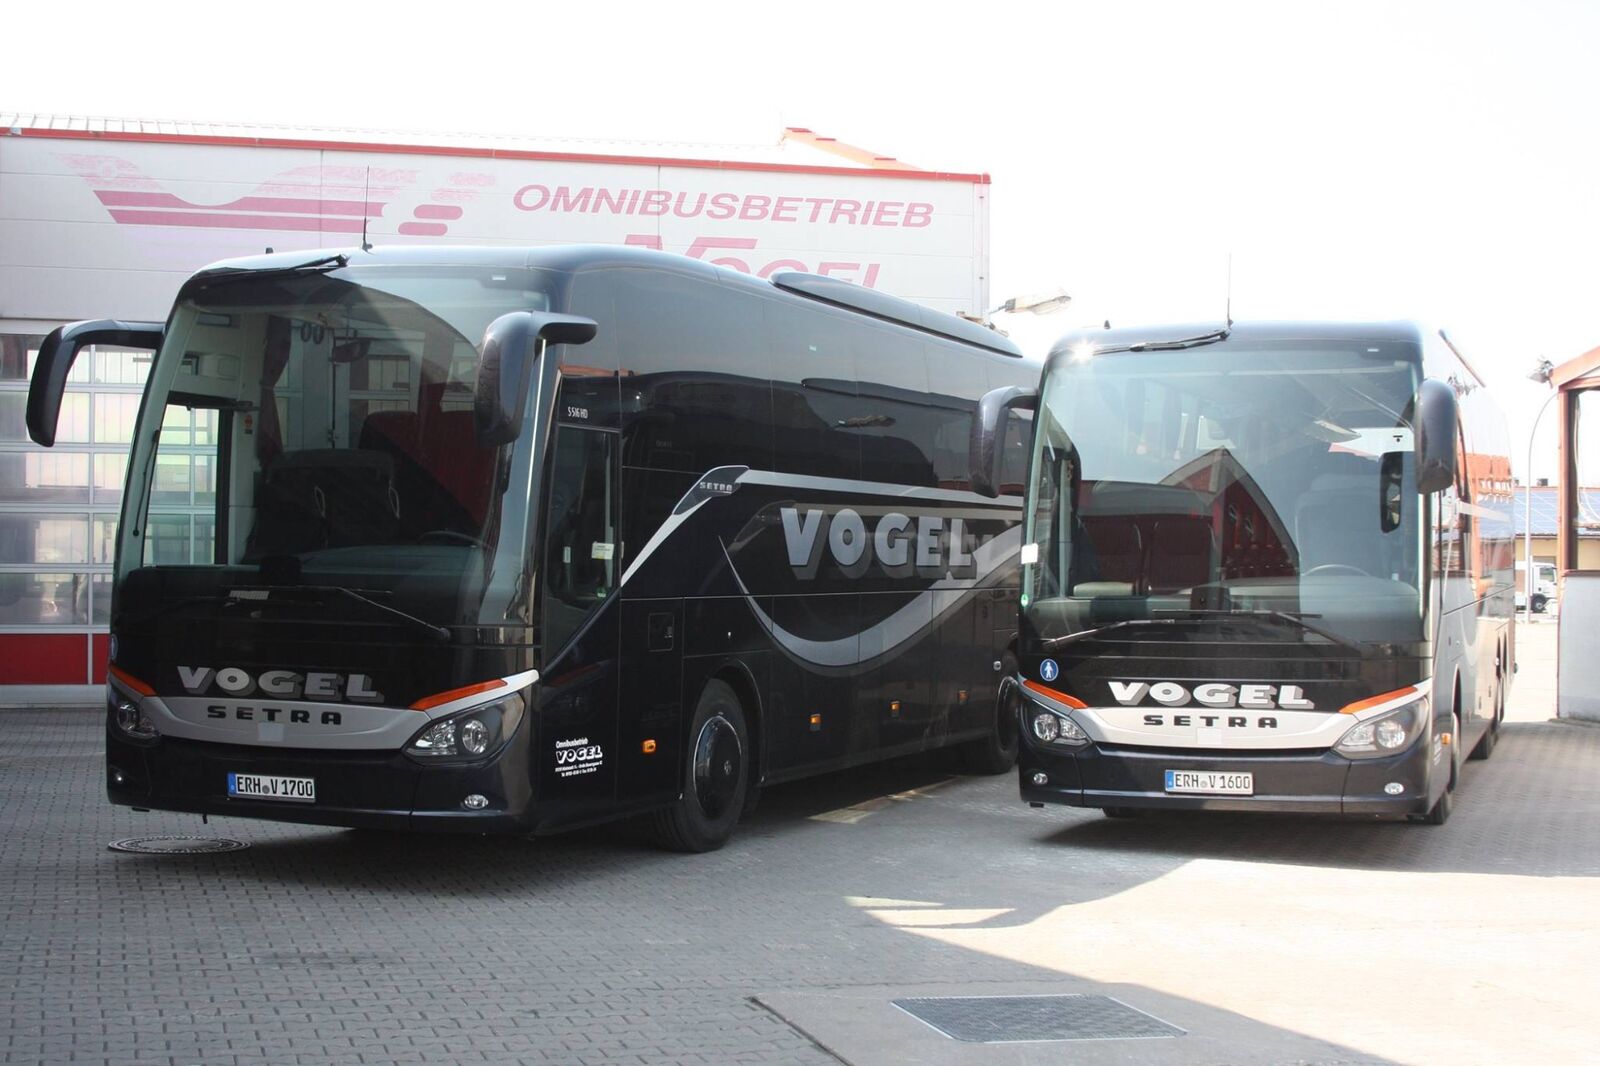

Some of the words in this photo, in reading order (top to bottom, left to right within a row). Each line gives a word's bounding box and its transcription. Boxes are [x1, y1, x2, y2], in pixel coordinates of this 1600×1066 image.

[513, 184, 934, 228] OMNIBUSBETRIEB
[699, 481, 733, 491] SETRA
[780, 507, 977, 580] VOGEL
[177, 666, 385, 703] VOGEL
[1107, 681, 1315, 709] VOGEL
[207, 705, 342, 725] SETRA
[1143, 715, 1278, 728] SETRA
[555, 745, 603, 764] VOGEL
[236, 776, 262, 793] ERH
[269, 779, 278, 794] V
[281, 780, 313, 797] 1700
[1175, 773, 1199, 788] ERH
[1209, 775, 1216, 788] V
[1219, 775, 1251, 789] 1600
